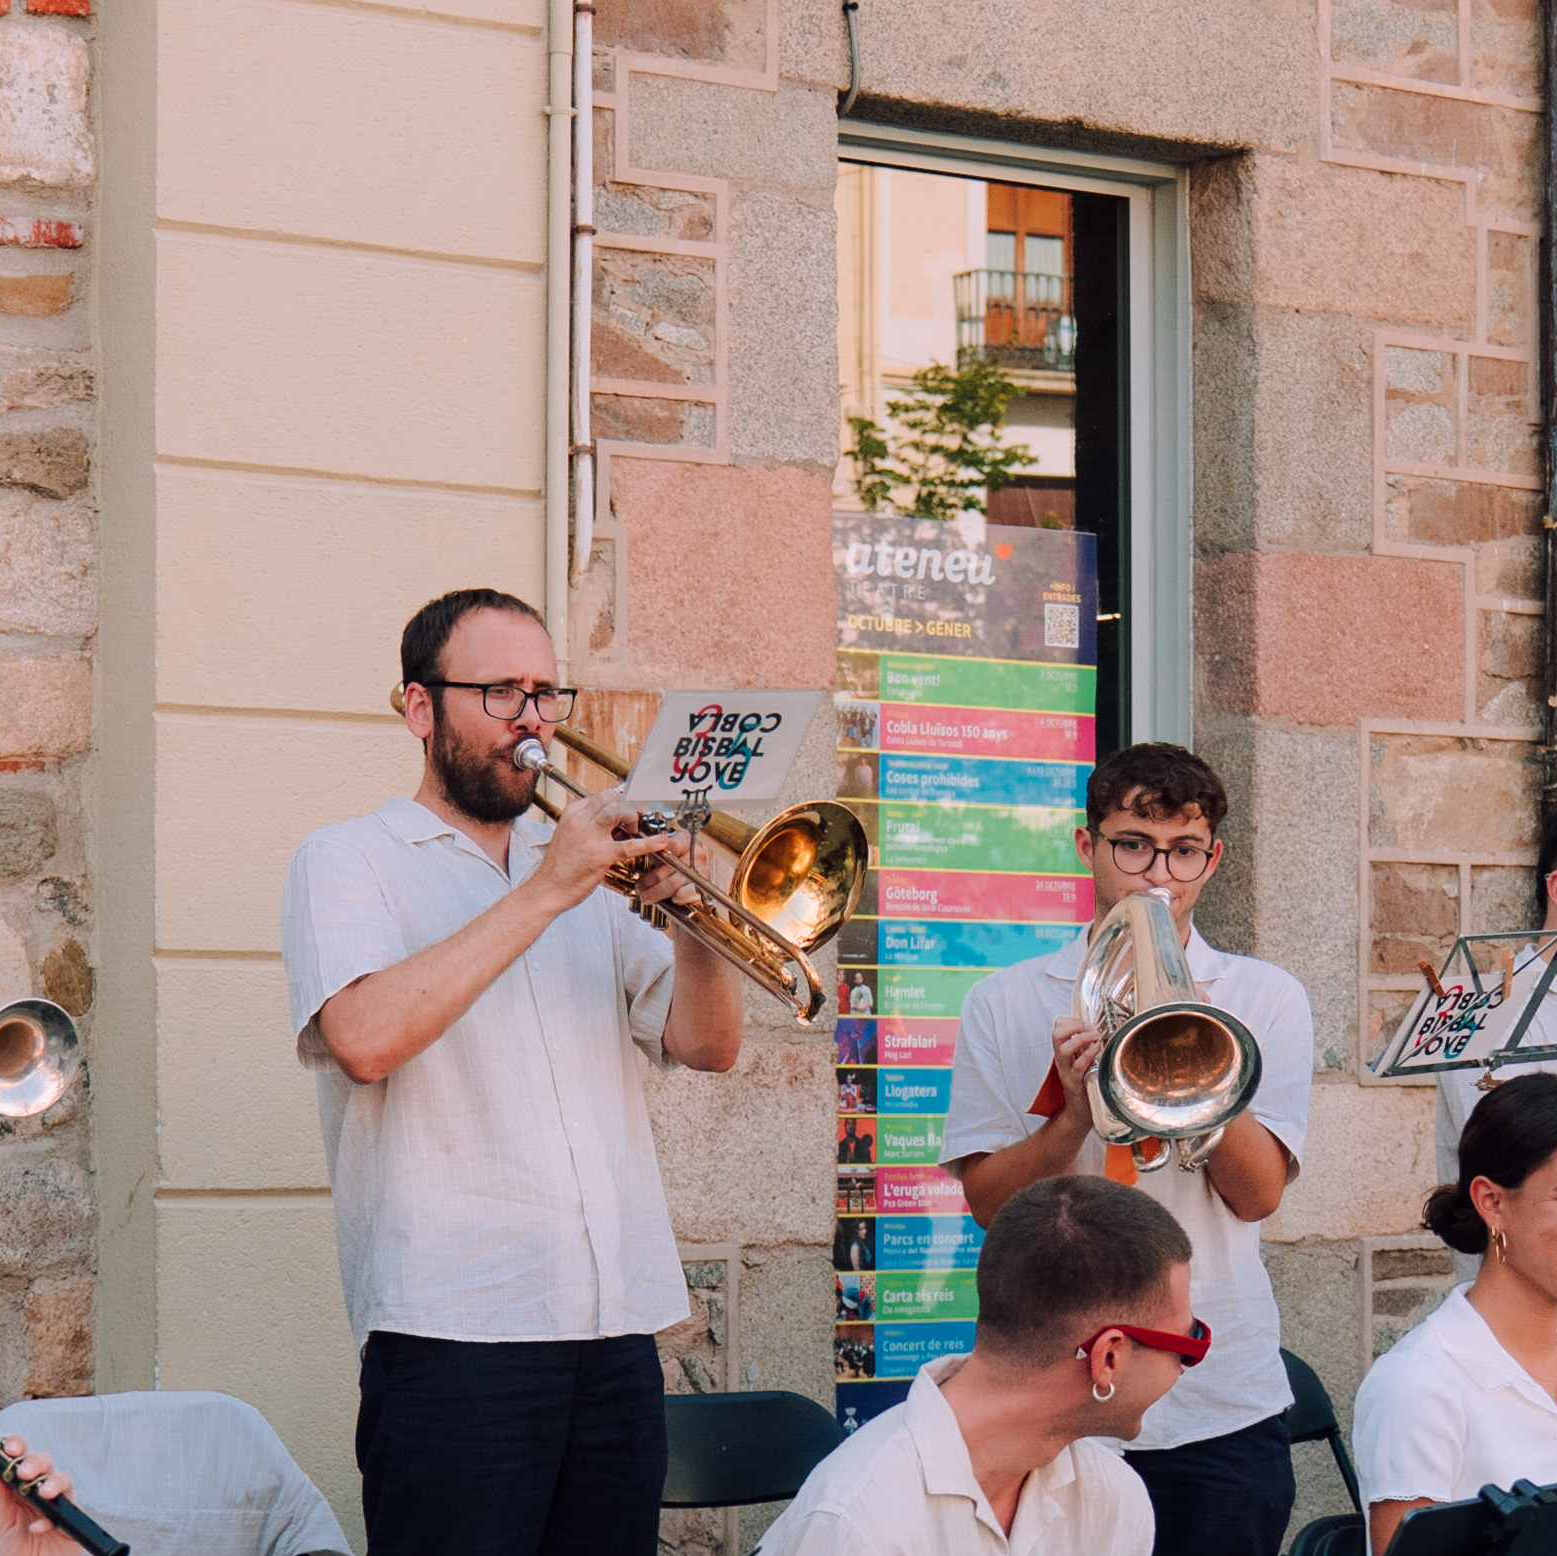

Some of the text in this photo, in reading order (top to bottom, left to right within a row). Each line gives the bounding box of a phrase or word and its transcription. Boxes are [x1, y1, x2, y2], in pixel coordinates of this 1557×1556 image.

[845, 540, 996, 585] ateneu
[849, 581, 926, 600] TEATRE
[847, 615, 911, 633] OCTUBRE
[926, 622, 971, 638] GENER
[887, 671, 941, 687] Bon vent!
[690, 713, 782, 733] COBLA
[887, 720, 1008, 743] Cobla Lluïsos 150 anys
[673, 737, 764, 757] BISBAL
[670, 762, 747, 783] JOVE
[886, 771, 980, 788] Coses prohibides
[886, 820, 920, 833] Frutal
[1044, 881, 1076, 891] OCTUBRE
[886, 886, 938, 904] Göteborg
[886, 935, 936, 950] Don Lifar
[885, 985, 925, 998] Hamlet
[885, 1034, 937, 1049] Strafalari
[885, 1051, 898, 1061] Mag
[885, 1084, 937, 1101] Llogatera
[884, 1134, 925, 1151] Vaques
[884, 1183, 925, 1199] L'eruga
[884, 1233, 974, 1245] Parcs en concert
[883, 1288, 954, 1303] Carta als reis
[883, 1337, 964, 1352] Concert de reis
